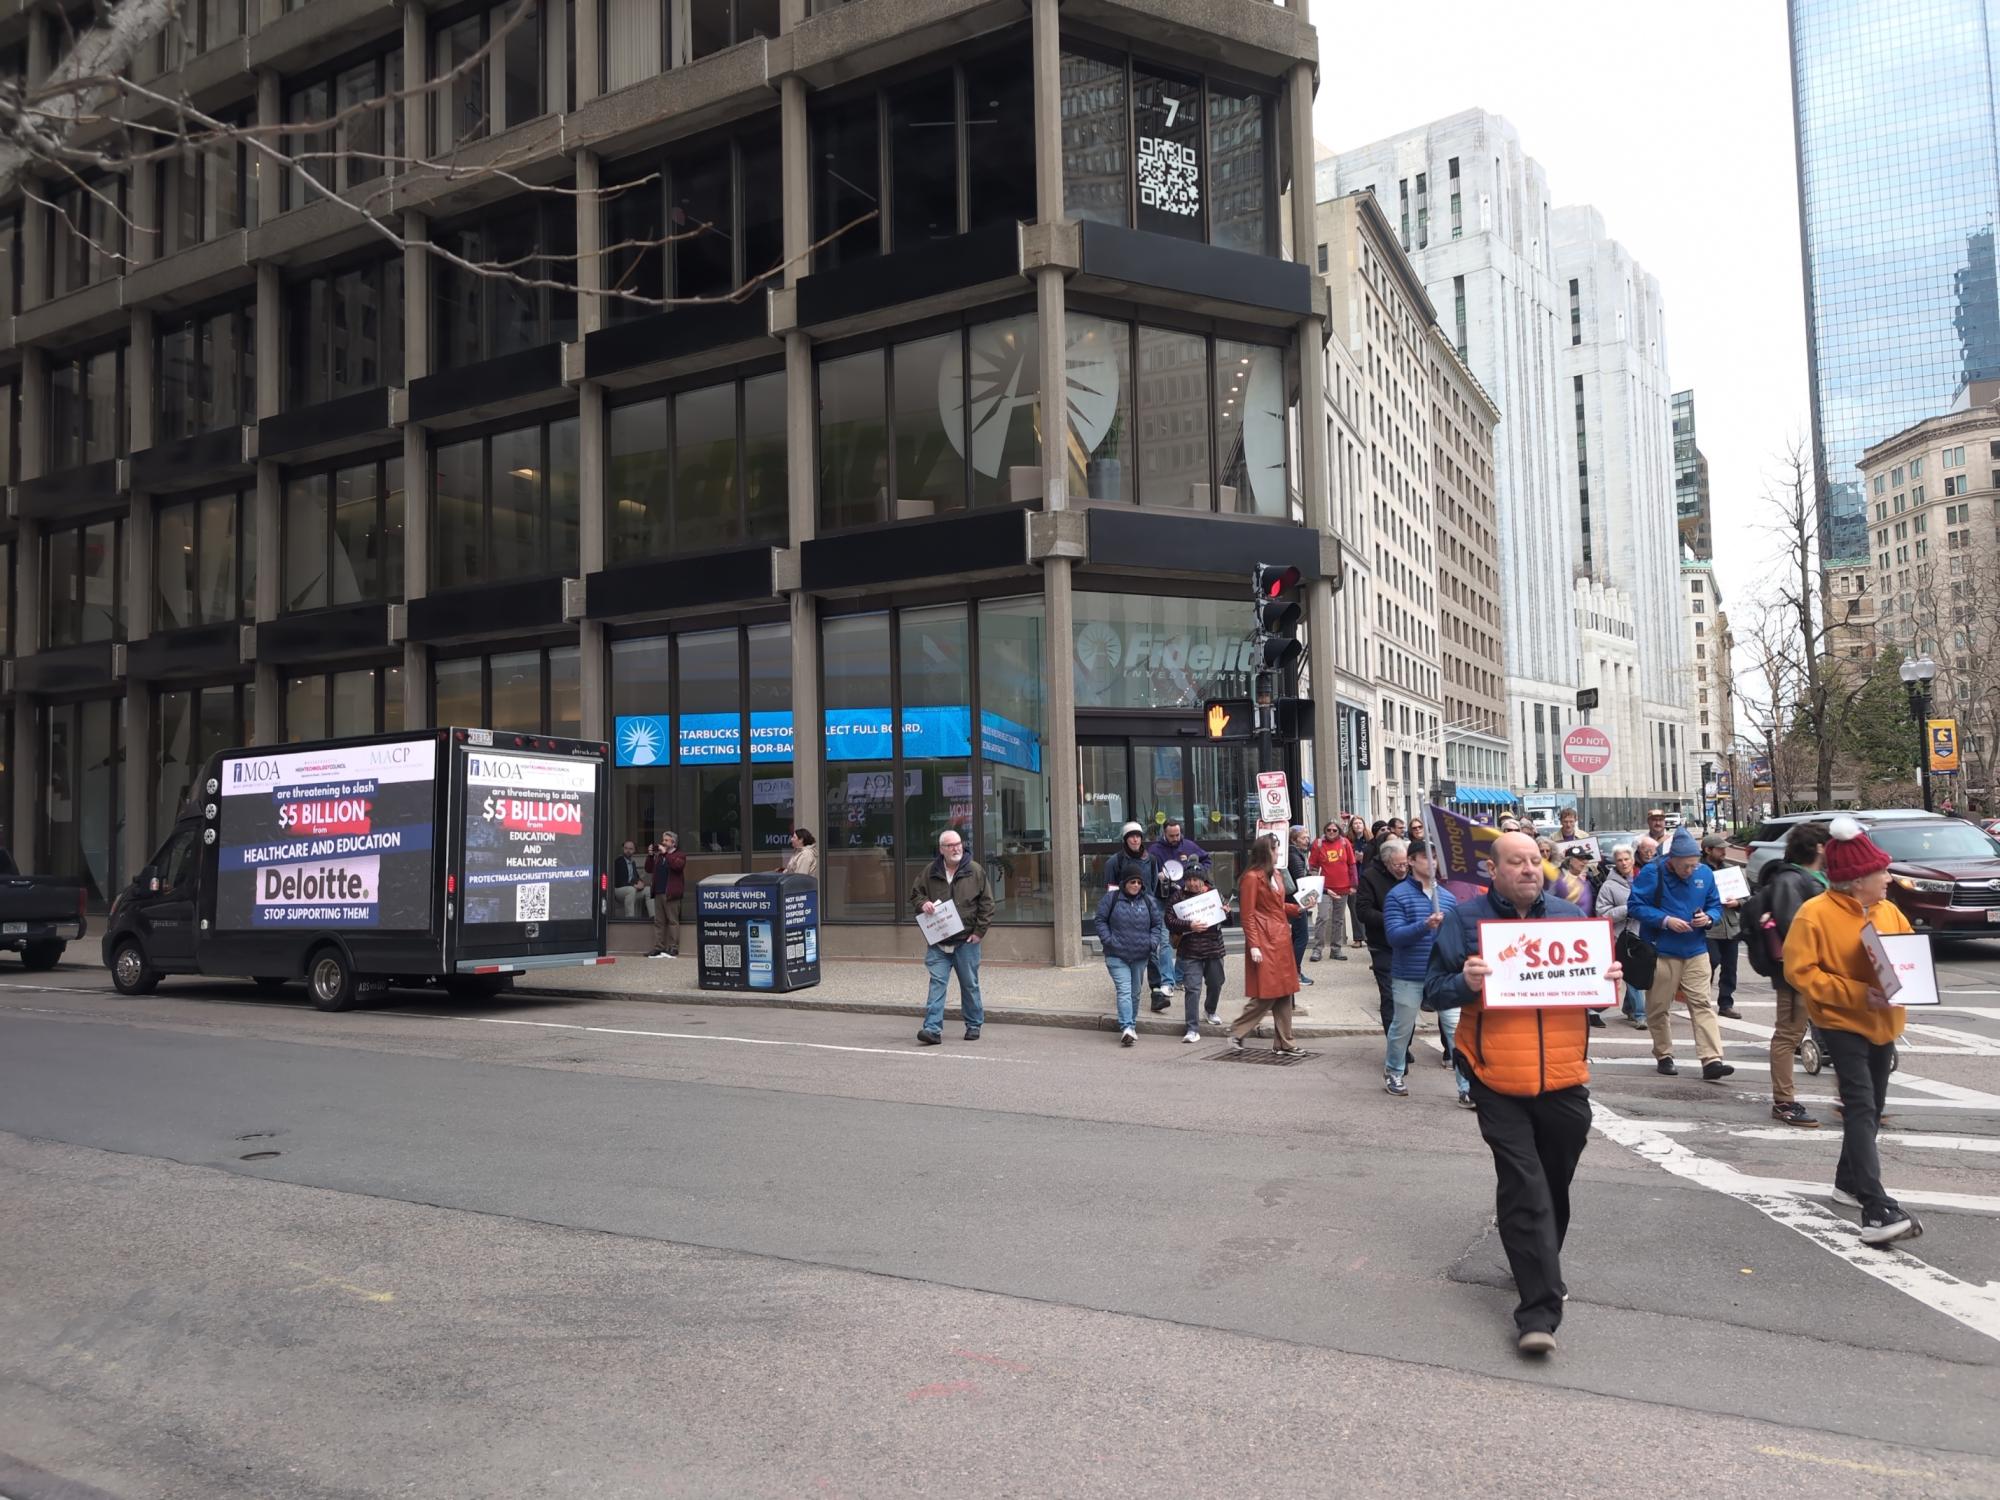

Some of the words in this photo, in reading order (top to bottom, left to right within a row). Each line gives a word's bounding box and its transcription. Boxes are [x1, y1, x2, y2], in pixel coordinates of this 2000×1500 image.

[1163, 96, 1180, 128] 7
[1124, 632, 1257, 672] Fidelit
[853, 725, 878, 735] FULL
[881, 723, 923, 735] BORD,
[1569, 736, 1583, 744] DO
[1586, 737, 1605, 745] NOT
[1572, 755, 1601, 764] ENTER
[243, 760, 281, 783] MOA
[482, 760, 523, 780] MOA
[277, 790, 291, 799] are
[292, 784, 340, 799] threatening
[341, 782, 352, 794] to
[352, 779, 374, 794] slash
[492, 788, 506, 796] are
[506, 786, 551, 800] threatening
[551, 791, 560, 800] to
[560, 791, 580, 801] slash
[278, 802, 298, 829] $5
[301, 800, 366, 825] BILLION
[482, 796, 507, 822] $5
[511, 800, 581, 823] BILLION
[312, 825, 328, 834] from
[509, 831, 556, 842] EDUCATION
[244, 842, 309, 864] HEALTHCARE
[310, 839, 335, 856] AND
[336, 831, 401, 854] EDUCATION
[523, 845, 542, 854] AND
[506, 857, 558, 868] HEALTHCARE
[264, 867, 370, 901] Deloitte.
[468, 869, 590, 884] PROTECTMASSACHUSETTSFUTURE.COM
[703, 891, 719, 900] NOT
[720, 891, 740, 899] SURE
[741, 891, 767, 899] WHEN
[703, 902, 728, 910] TRASH
[729, 901, 758, 910] PICKUP
[759, 901, 772, 910] IS?
[263, 907, 286, 921] STOP
[286, 907, 342, 920] SUPPORTING
[342, 906, 369, 920] THEM!
[728, 920, 737, 928] the
[704, 929, 718, 937] Trash
[718, 930, 729, 938] Day
[1524, 938, 1589, 968] S.O.S
[1519, 971, 1544, 981] SAVE
[1547, 969, 1566, 980] OUR
[1568, 966, 1597, 977] STATE
